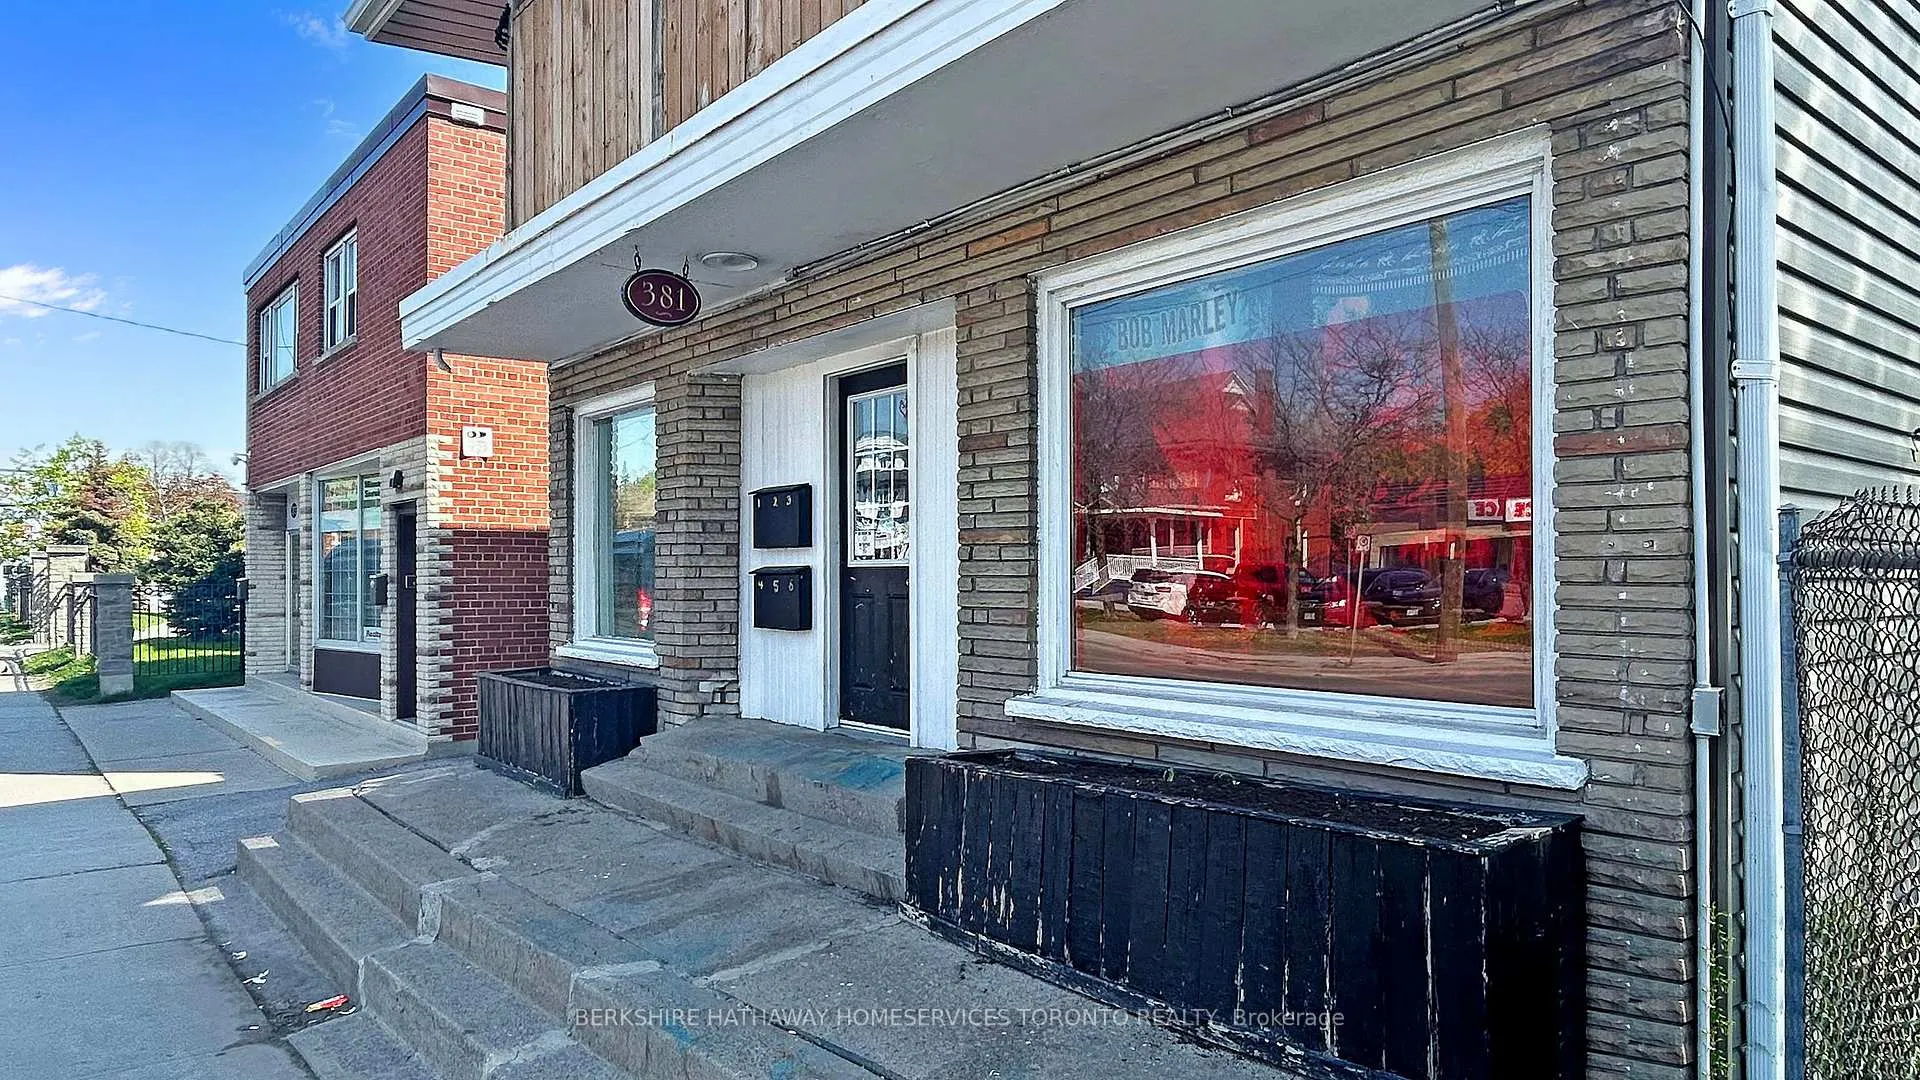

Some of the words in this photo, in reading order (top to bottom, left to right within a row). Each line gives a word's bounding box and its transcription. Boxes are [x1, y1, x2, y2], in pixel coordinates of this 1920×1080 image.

[641, 280, 685, 312] 381
[1116, 315, 1153, 350] BOB
[1159, 290, 1239, 345] MARLEY
[772, 496, 779, 508] 2
[785, 495, 792, 506] 3
[757, 580, 764, 590] 4
[772, 579, 780, 593] 5
